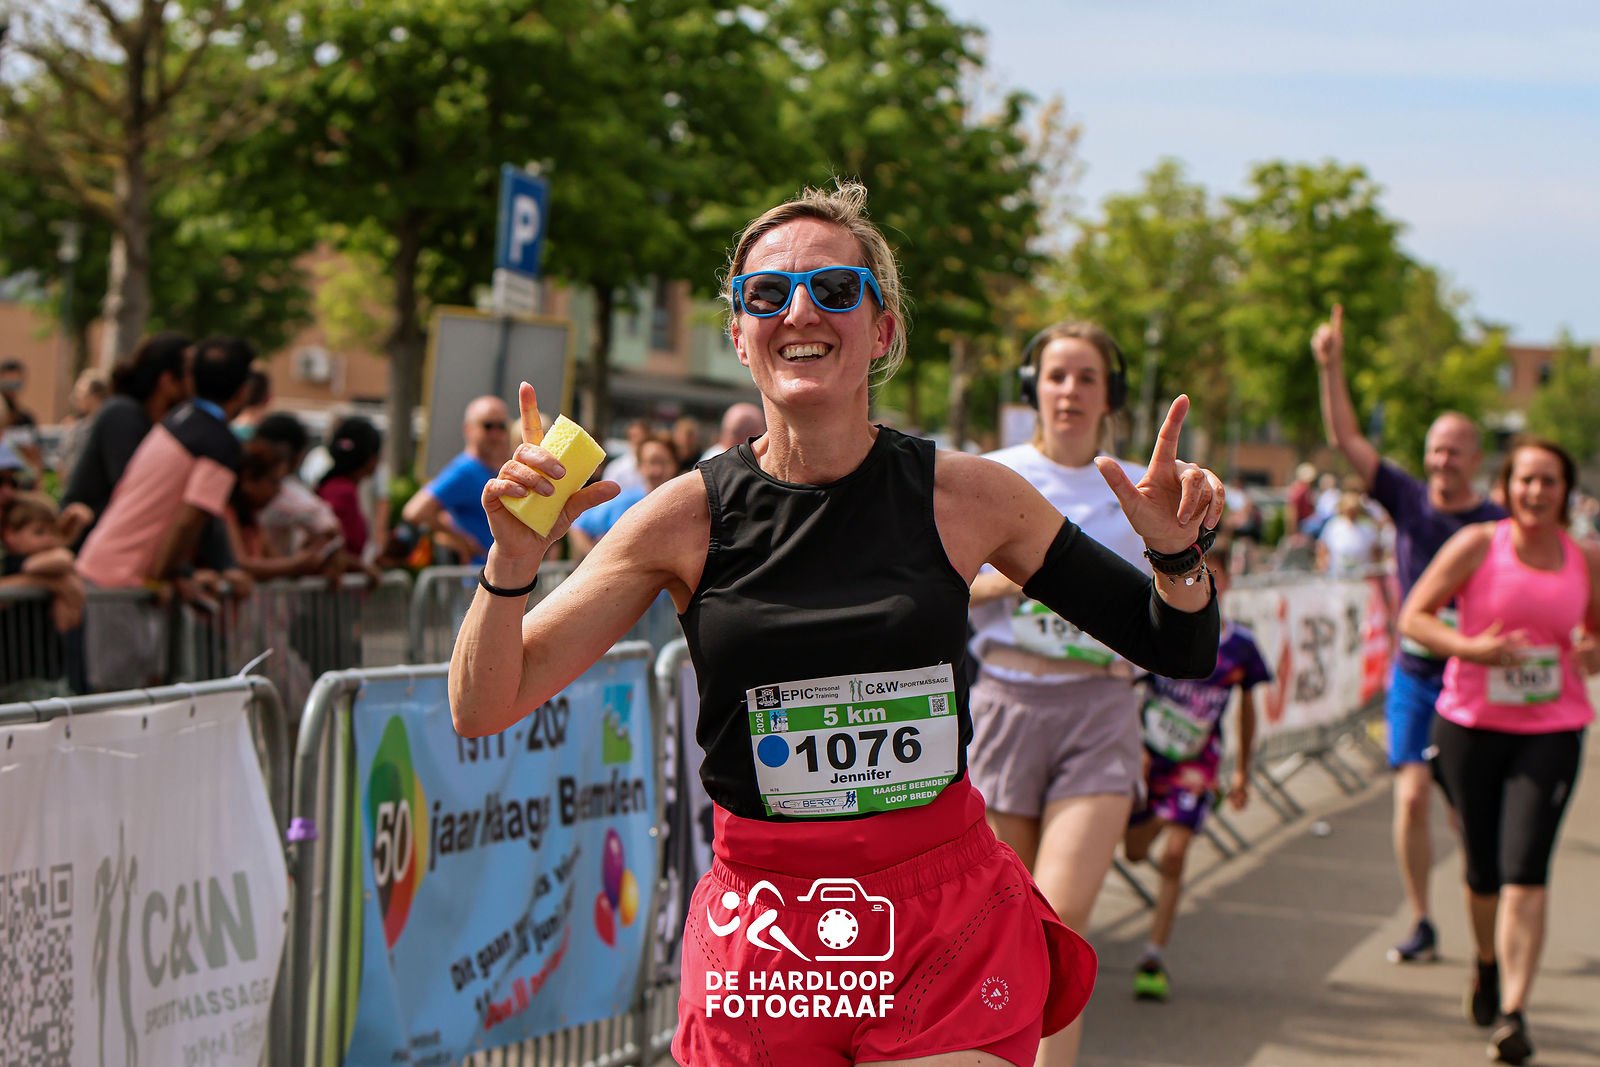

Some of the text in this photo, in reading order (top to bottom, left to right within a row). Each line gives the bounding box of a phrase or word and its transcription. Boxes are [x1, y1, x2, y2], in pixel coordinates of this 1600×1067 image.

[509, 194, 540, 263] P
[781, 688, 814, 702] EPIC
[865, 677, 949, 695] C&W SPORTMASSAGE
[756, 712, 765, 734] 2026
[823, 705, 887, 726] 5 km
[795, 726, 922, 773] 1076
[830, 769, 892, 785] Jennifer
[872, 777, 949, 795] HAAGSE BEEMDEN
[885, 790, 938, 804] LOOP BREDA
[373, 797, 413, 888] 50
[141, 870, 258, 989] C&W
